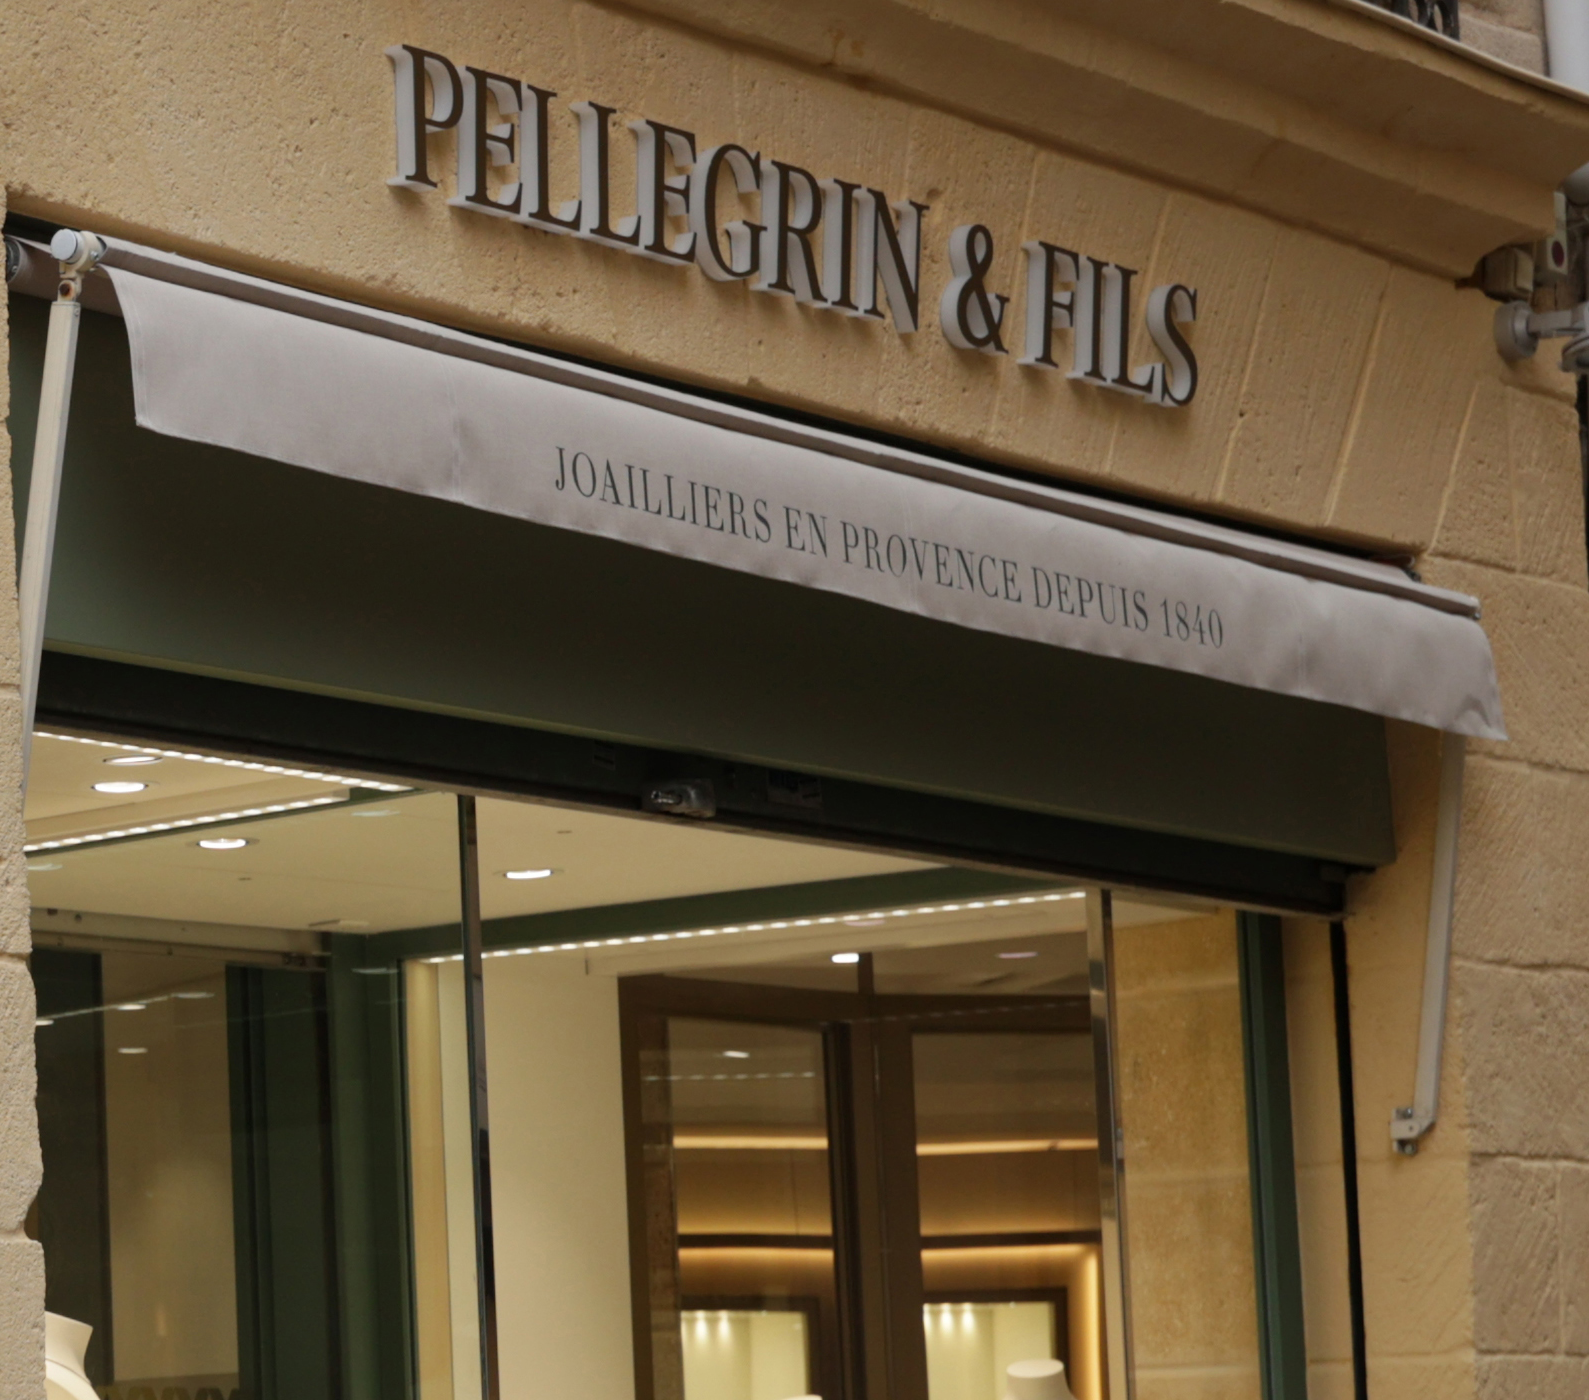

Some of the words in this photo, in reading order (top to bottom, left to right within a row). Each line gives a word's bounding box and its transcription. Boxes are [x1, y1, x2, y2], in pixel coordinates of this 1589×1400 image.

[385, 43, 929, 335] PELLEGRIN
[941, 223, 1011, 355] &
[1016, 238, 1200, 407] FILS
[554, 445, 773, 546] JOAILLIERS
[785, 507, 829, 558] EN
[840, 520, 1023, 603] PROVENCE
[1030, 567, 1150, 634] DEPUIS
[1158, 598, 1224, 649] 1840
